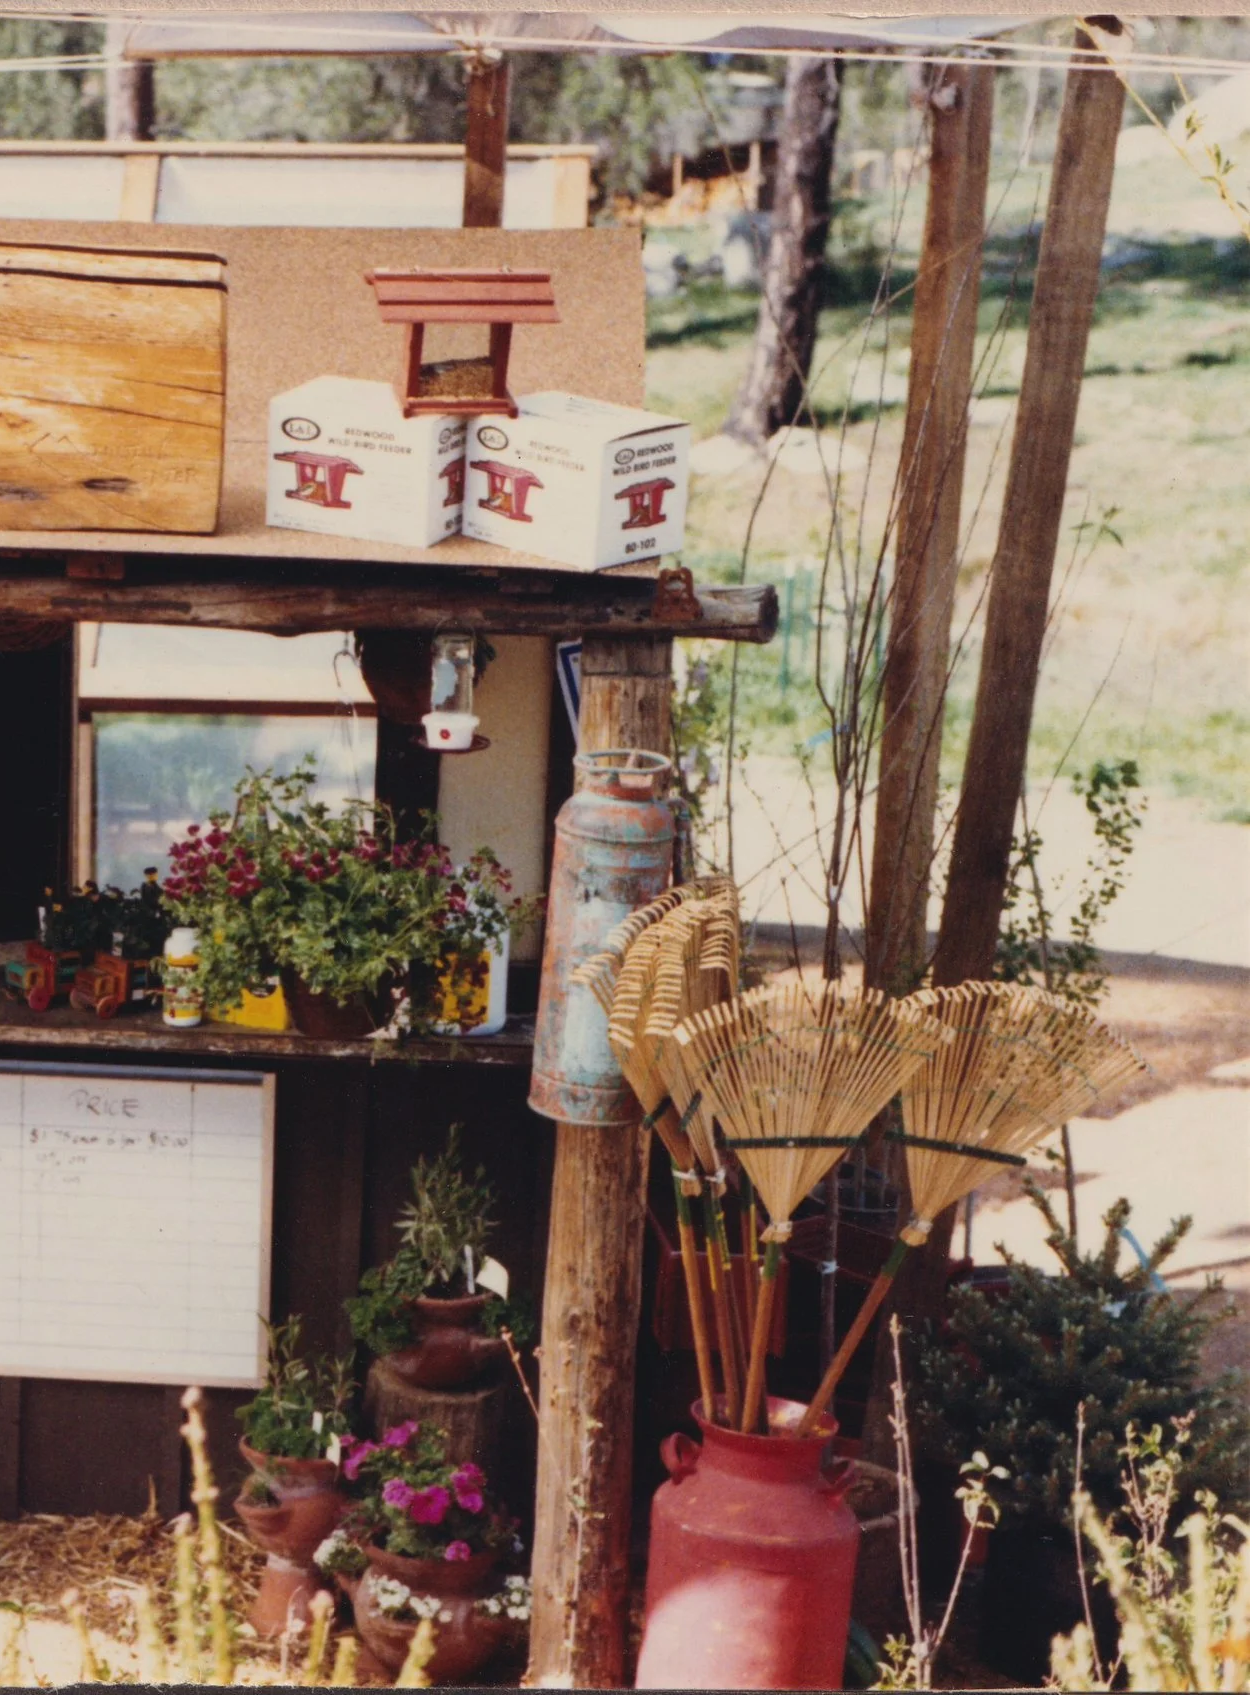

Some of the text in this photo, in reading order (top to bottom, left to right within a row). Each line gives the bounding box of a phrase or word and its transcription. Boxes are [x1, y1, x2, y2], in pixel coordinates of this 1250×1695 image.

[345, 427, 395, 441] REDWOOD
[353, 440, 376, 450] BIRD
[378, 443, 412, 455] FEEDER
[636, 442, 675, 457] REDWOOD
[613, 455, 677, 476] WILD BIRD FEEDER
[70, 1088, 140, 1118] PRICE
